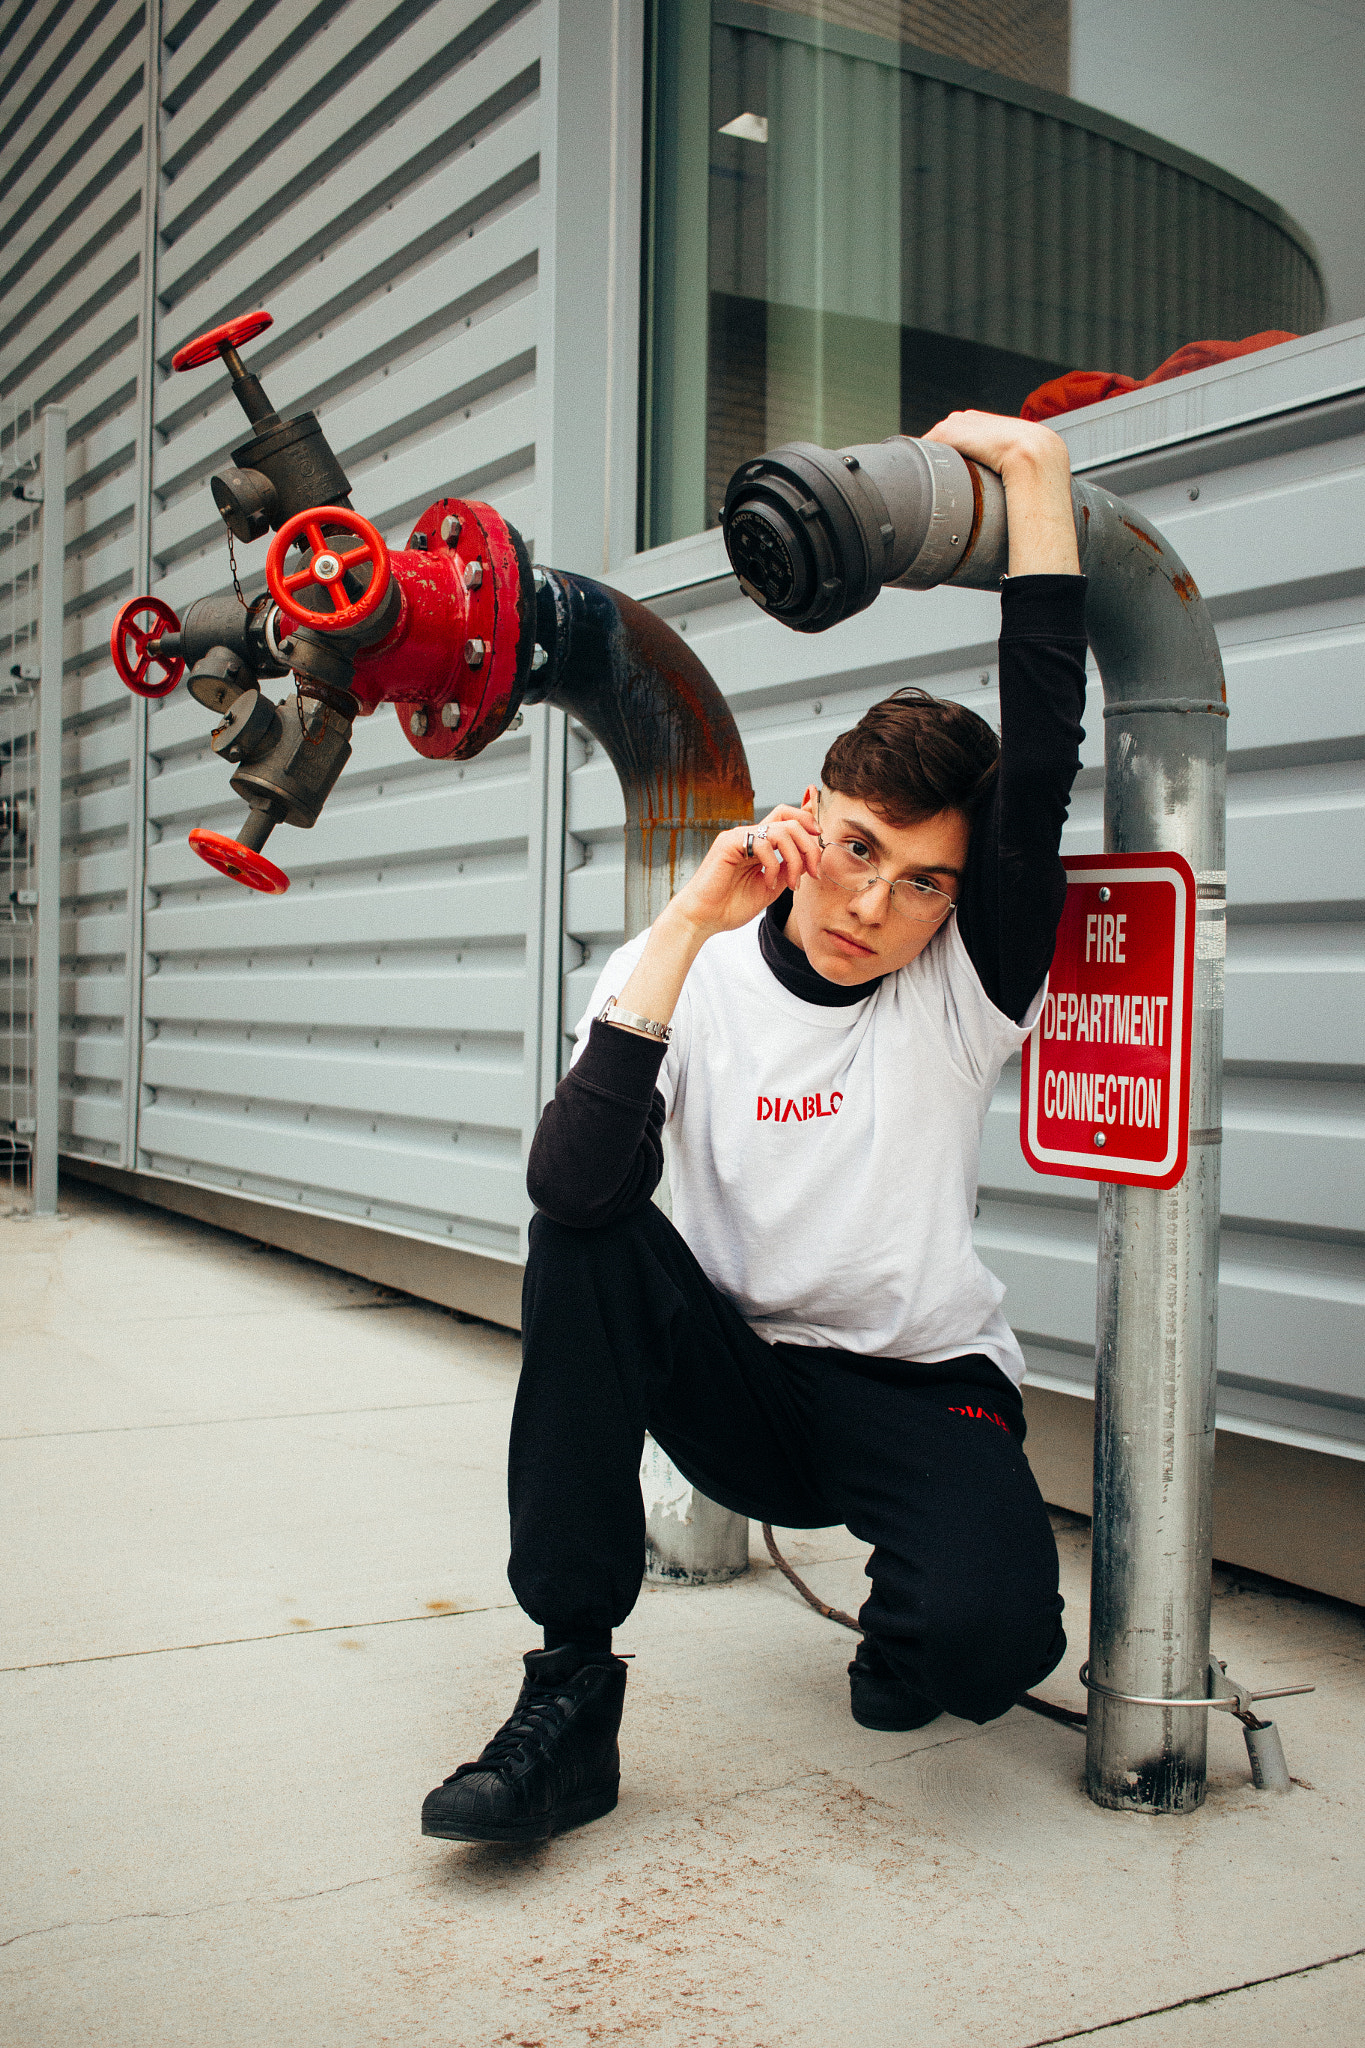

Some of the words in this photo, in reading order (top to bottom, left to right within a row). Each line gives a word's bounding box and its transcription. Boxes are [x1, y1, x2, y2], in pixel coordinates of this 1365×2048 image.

[1085, 914, 1127, 963] FIRE
[1043, 993, 1168, 1047] DEPARTMENT
[757, 1091, 843, 1122] DIABLO
[1044, 1069, 1162, 1128] CONNECTION
